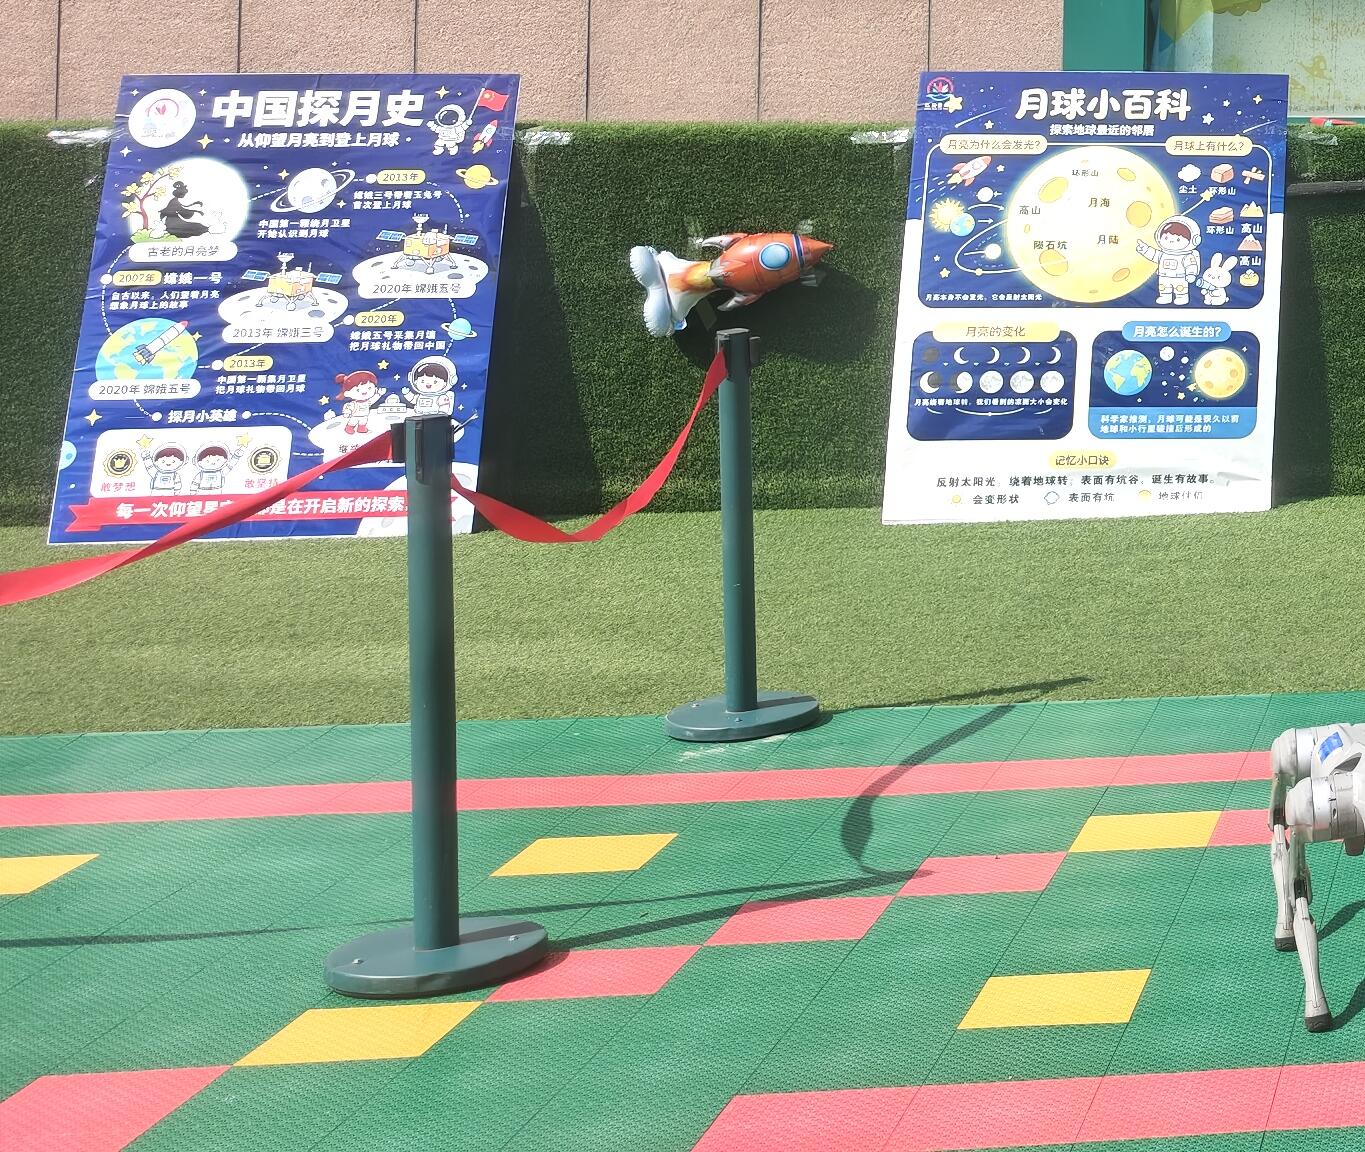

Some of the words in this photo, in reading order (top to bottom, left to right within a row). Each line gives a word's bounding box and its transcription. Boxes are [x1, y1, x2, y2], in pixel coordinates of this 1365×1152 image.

[211, 89, 425, 128] 中国探月史
[1014, 87, 1192, 122] 月球小百科
[1049, 123, 1156, 137] 探索地球最近的邻居
[237, 132, 401, 149] 从仰望月亮到登上月球
[382, 172, 420, 182] 2013年
[352, 200, 413, 210] 首次登上月球
[1088, 197, 1111, 209] 月海
[1019, 205, 1042, 216] 高山
[1240, 222, 1263, 234] 高山
[1033, 240, 1069, 251] 陨石坑
[1096, 234, 1120, 246] 月陆
[147, 245, 221, 258] 古老的月亮梦
[1239, 255, 1262, 266] 高山
[118, 272, 156, 283] 2007年
[372, 283, 413, 295] 2020年
[360, 313, 398, 324] 2020年
[232, 327, 274, 338] 2013年
[965, 325, 1027, 338] 月亮的变化
[229, 358, 266, 369] 2013年
[98, 384, 141, 396] 2020年
[167, 408, 238, 424] 探月小英雄
[1054, 454, 1110, 466] 记忆小口诀
[972, 494, 1020, 505] 会变形状
[1068, 492, 1116, 503] 表面有坑
